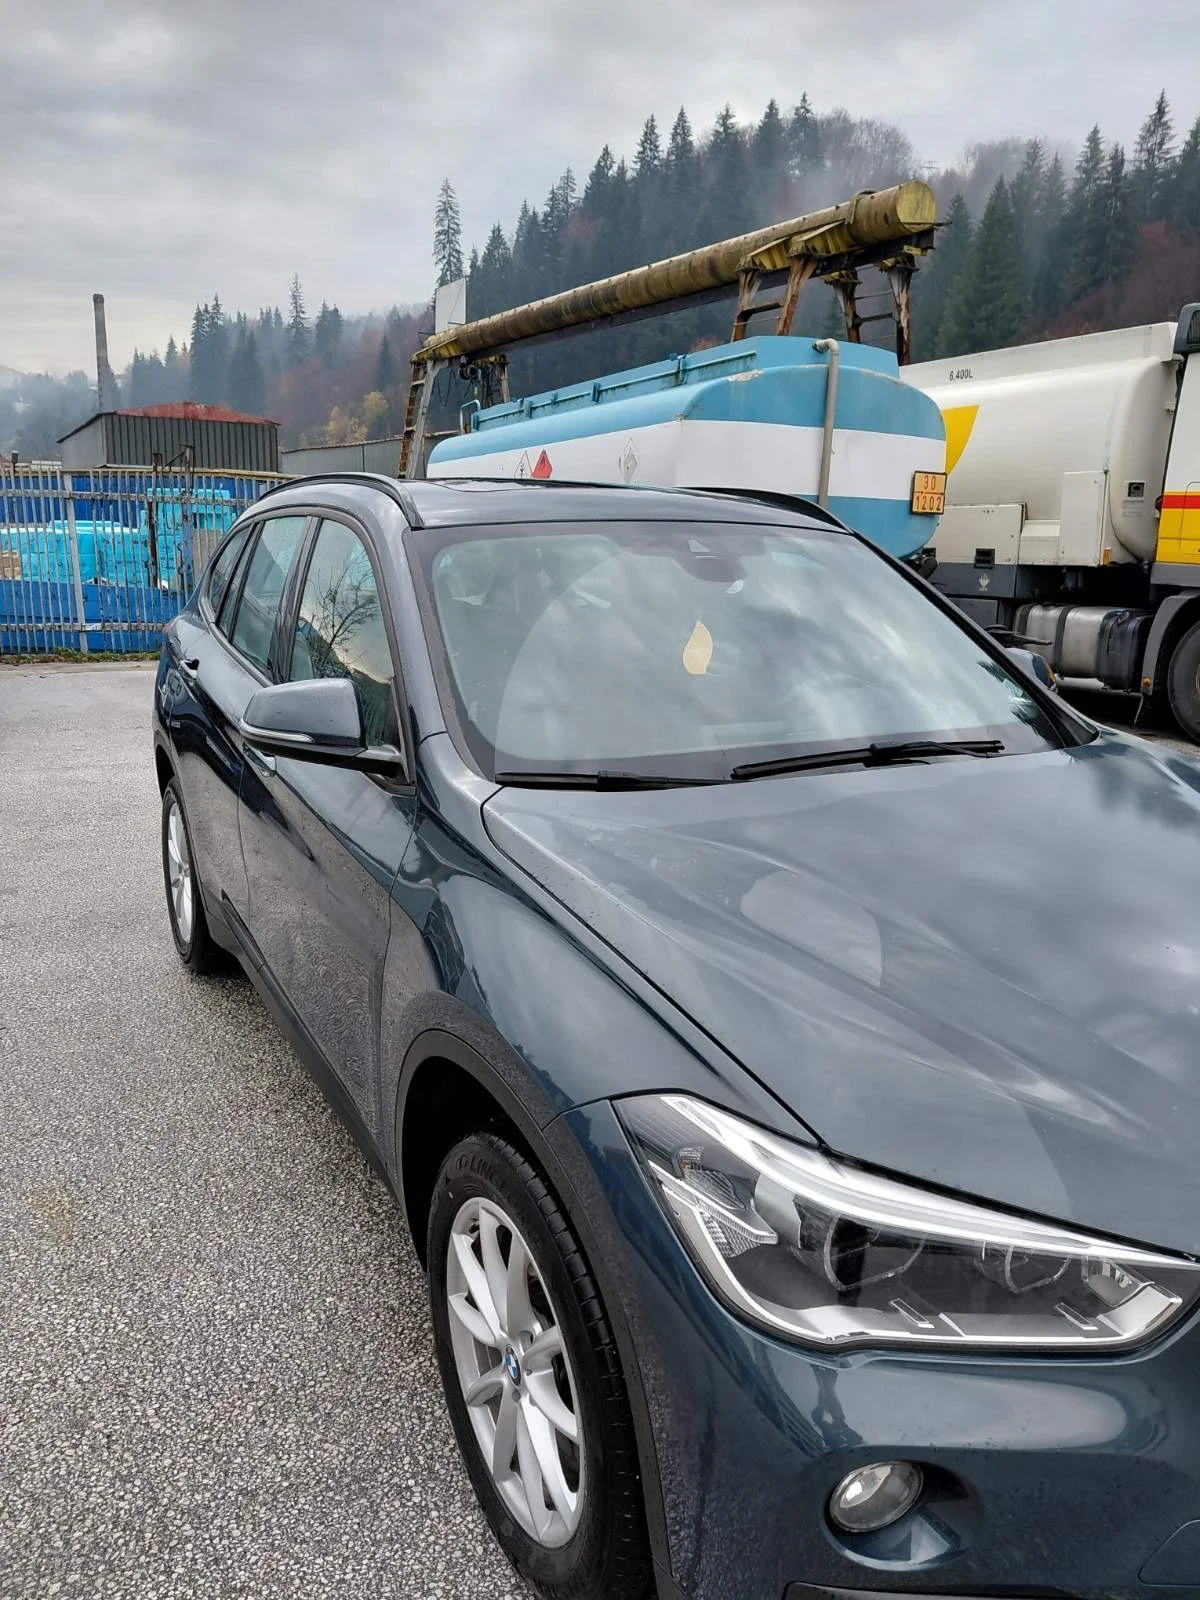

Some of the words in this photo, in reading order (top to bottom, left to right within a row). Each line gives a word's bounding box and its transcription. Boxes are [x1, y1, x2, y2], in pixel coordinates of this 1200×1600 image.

[949, 368, 974, 382] 6,400L
[923, 475, 937, 490] 30
[915, 495, 942, 511] 1202
